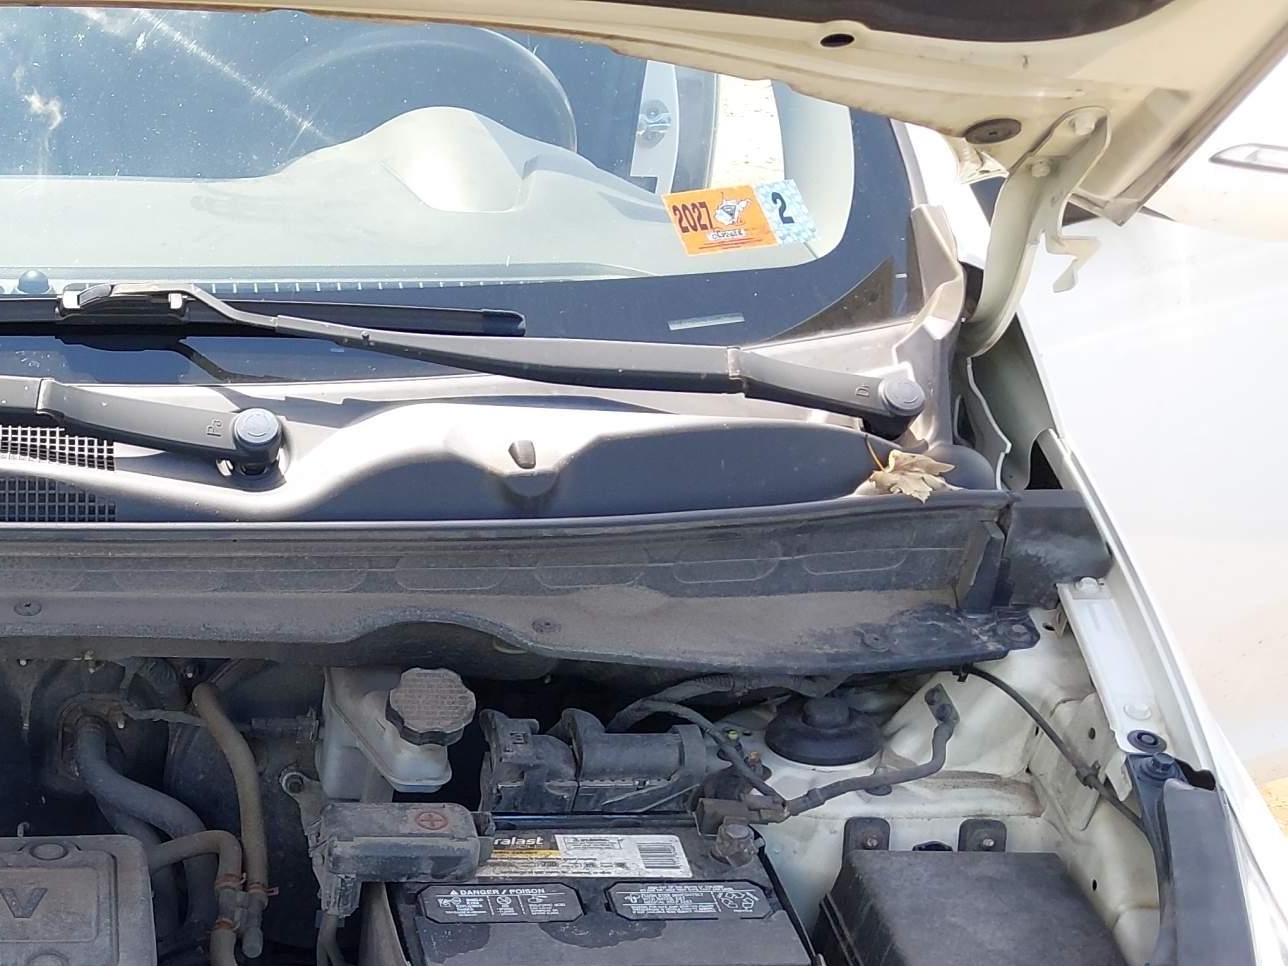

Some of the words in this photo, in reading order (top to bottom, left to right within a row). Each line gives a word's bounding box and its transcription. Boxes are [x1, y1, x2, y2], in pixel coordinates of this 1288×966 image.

[673, 201, 713, 233] 2027
[772, 192, 794, 224] 2
[493, 836, 544, 845] ralast
